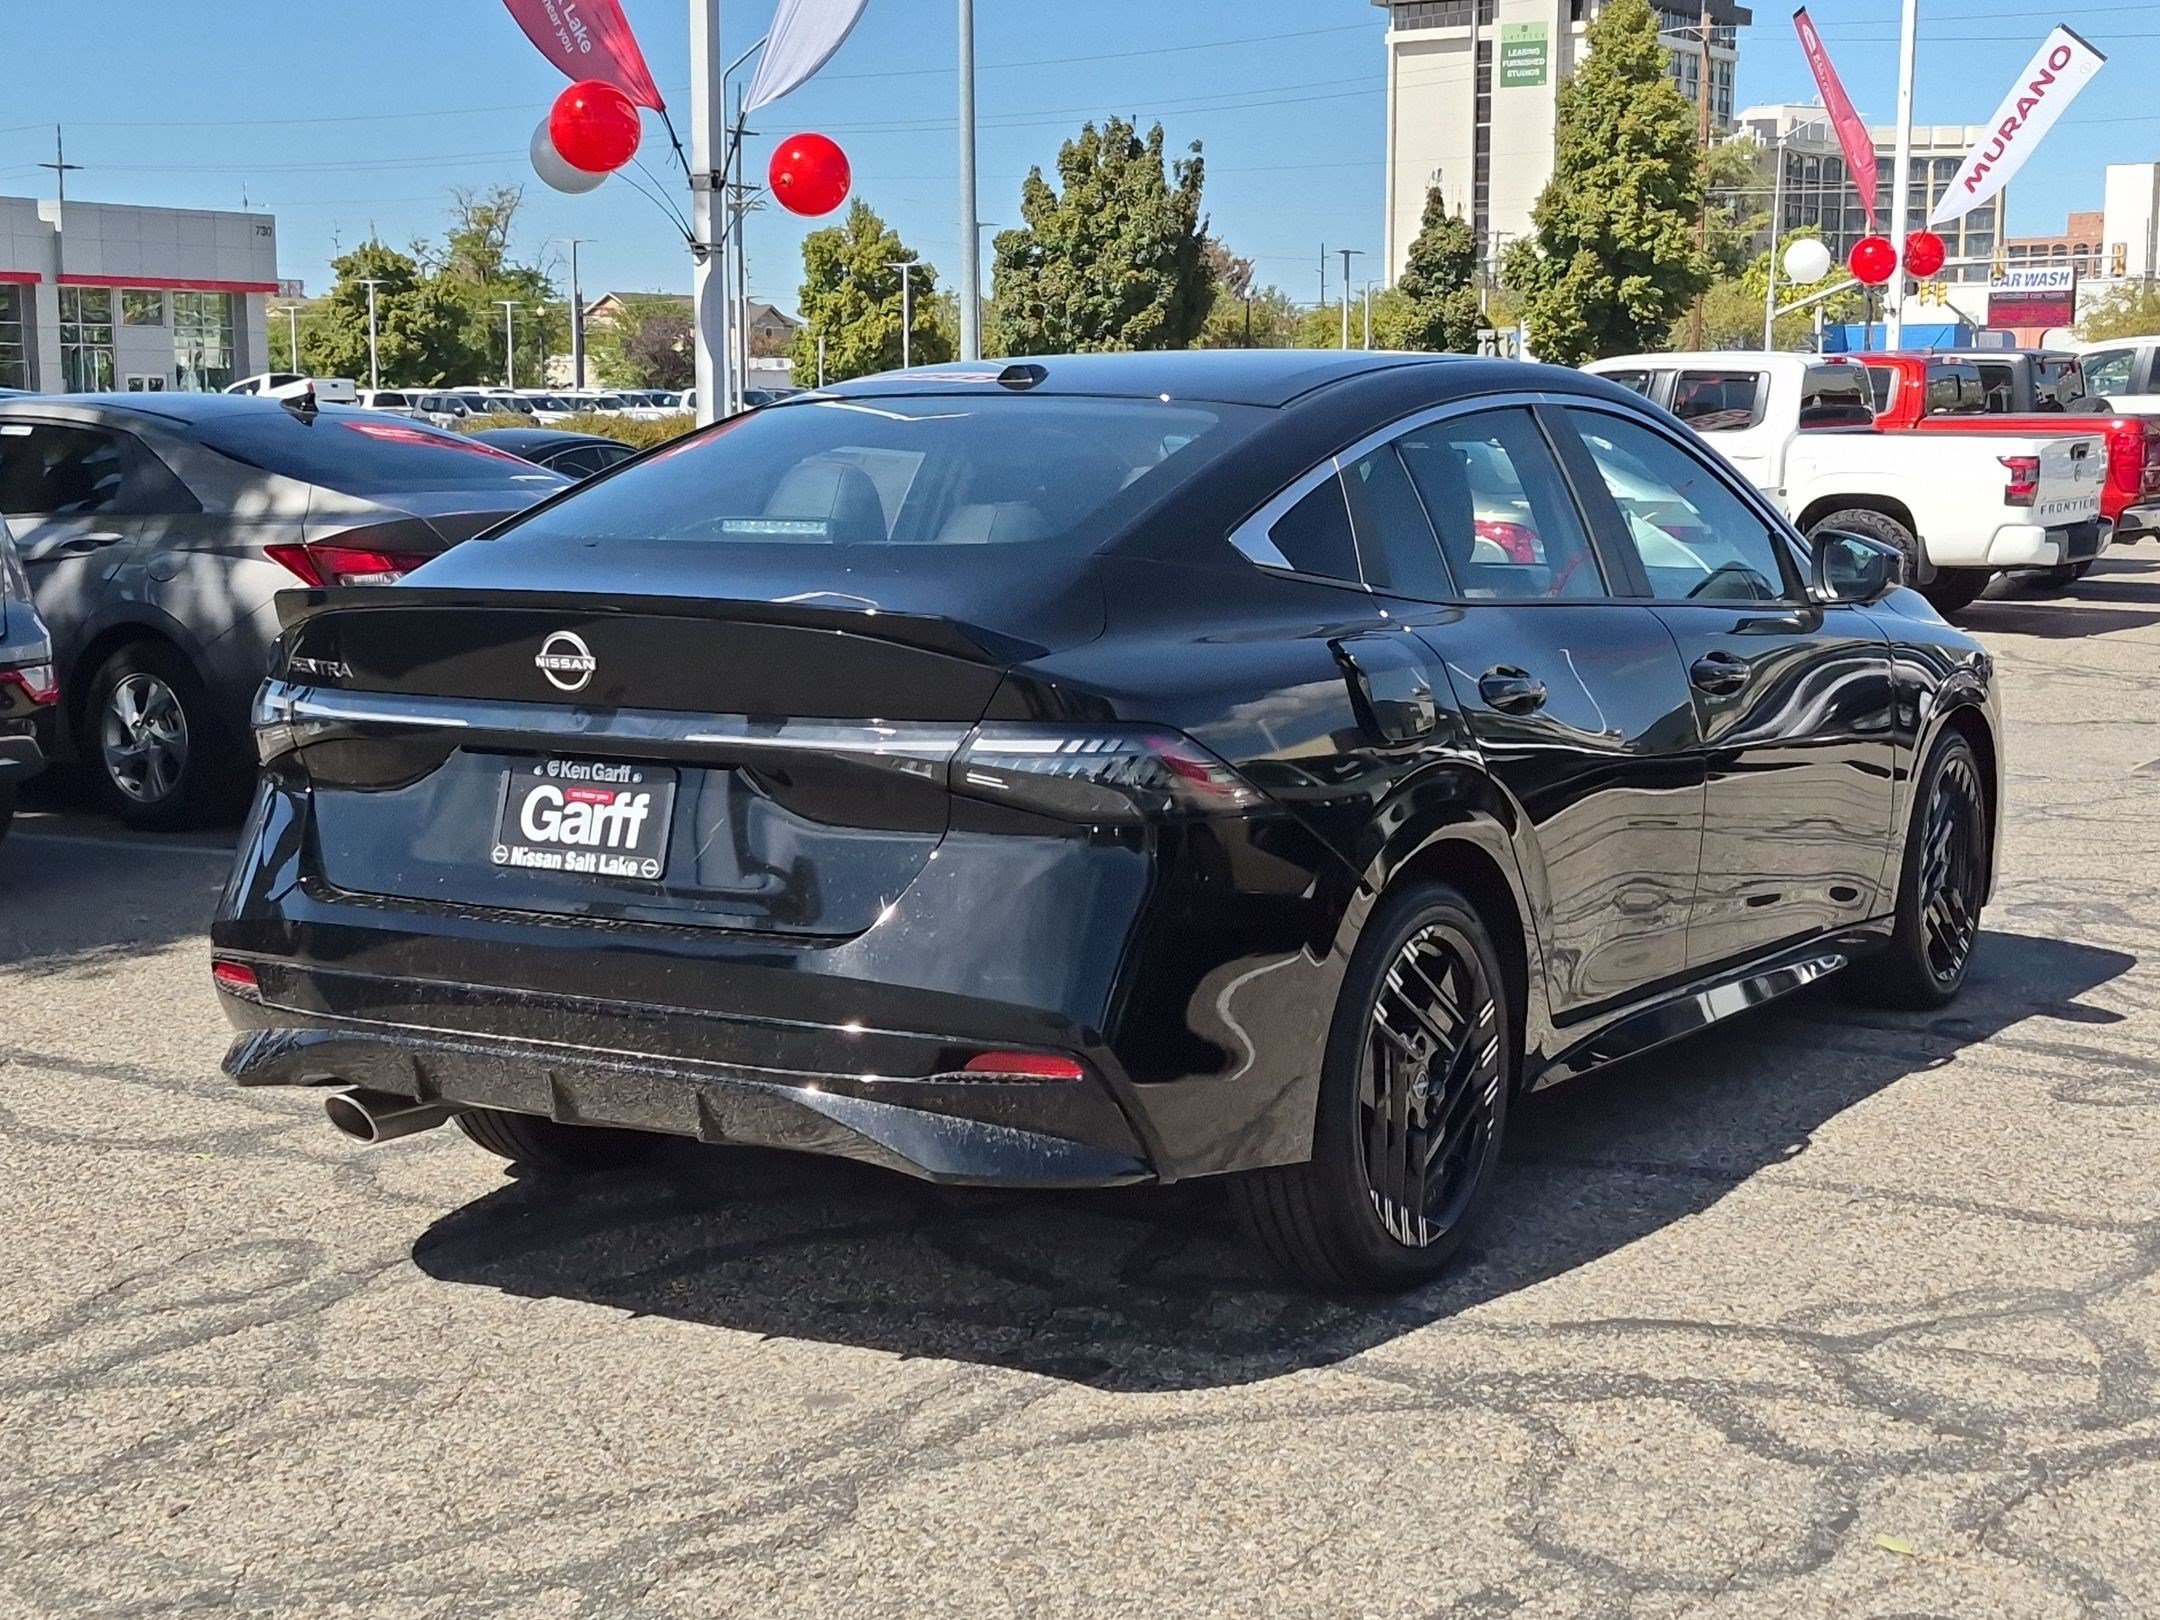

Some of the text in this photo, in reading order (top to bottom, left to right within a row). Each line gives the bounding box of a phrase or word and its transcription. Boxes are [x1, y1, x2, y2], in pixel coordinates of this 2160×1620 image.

[556, 27, 574, 54] you
[563, 3, 592, 54] Lake
[1964, 44, 2072, 194] MURANO
[255, 225, 272, 237] 730
[2025, 271, 2070, 287] WASH
[2040, 498, 2095, 515] FRONTIER
[535, 656, 596, 671] NISSAN
[560, 760, 632, 783] Ken Garff
[520, 784, 651, 849] Garff
[511, 846, 638, 876] Nissan Salt Lake
